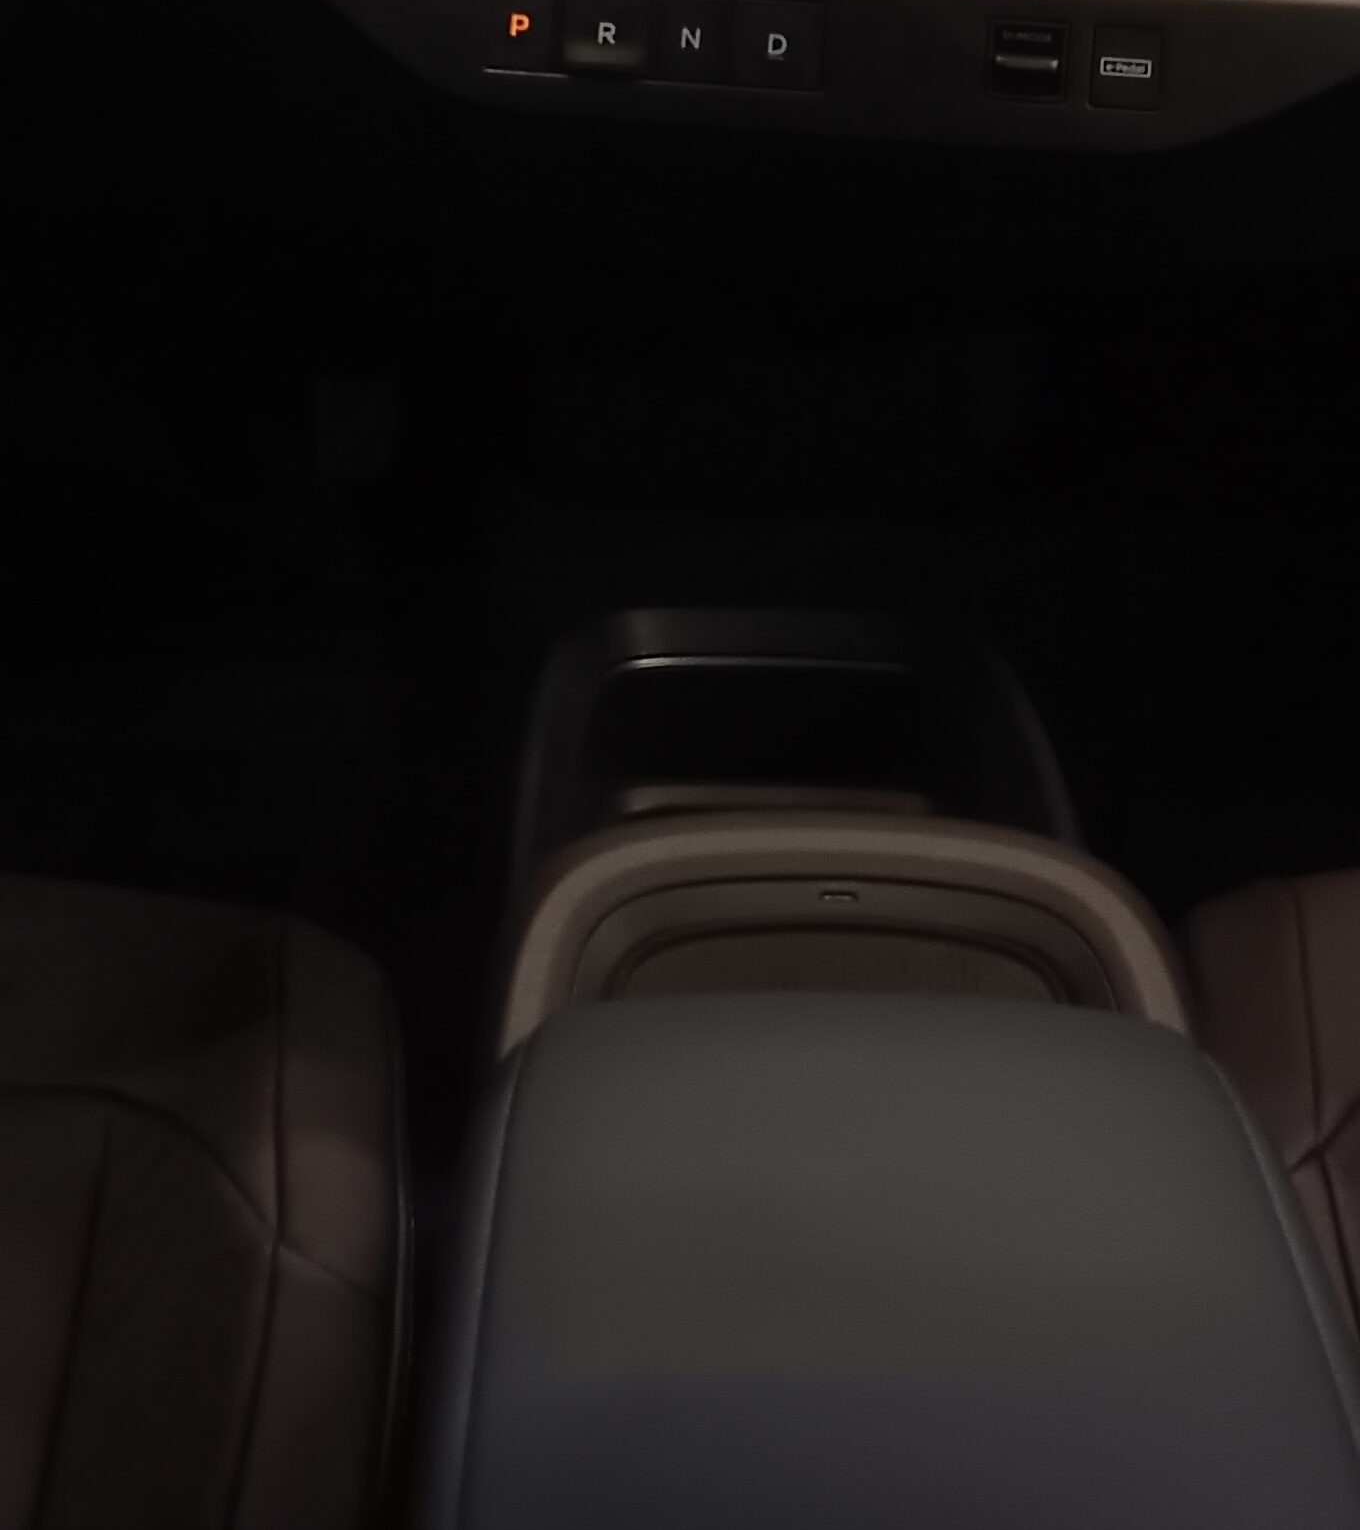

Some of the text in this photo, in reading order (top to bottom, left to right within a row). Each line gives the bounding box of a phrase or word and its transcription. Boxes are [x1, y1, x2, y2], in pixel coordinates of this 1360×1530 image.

[509, 13, 788, 55] P R N D
